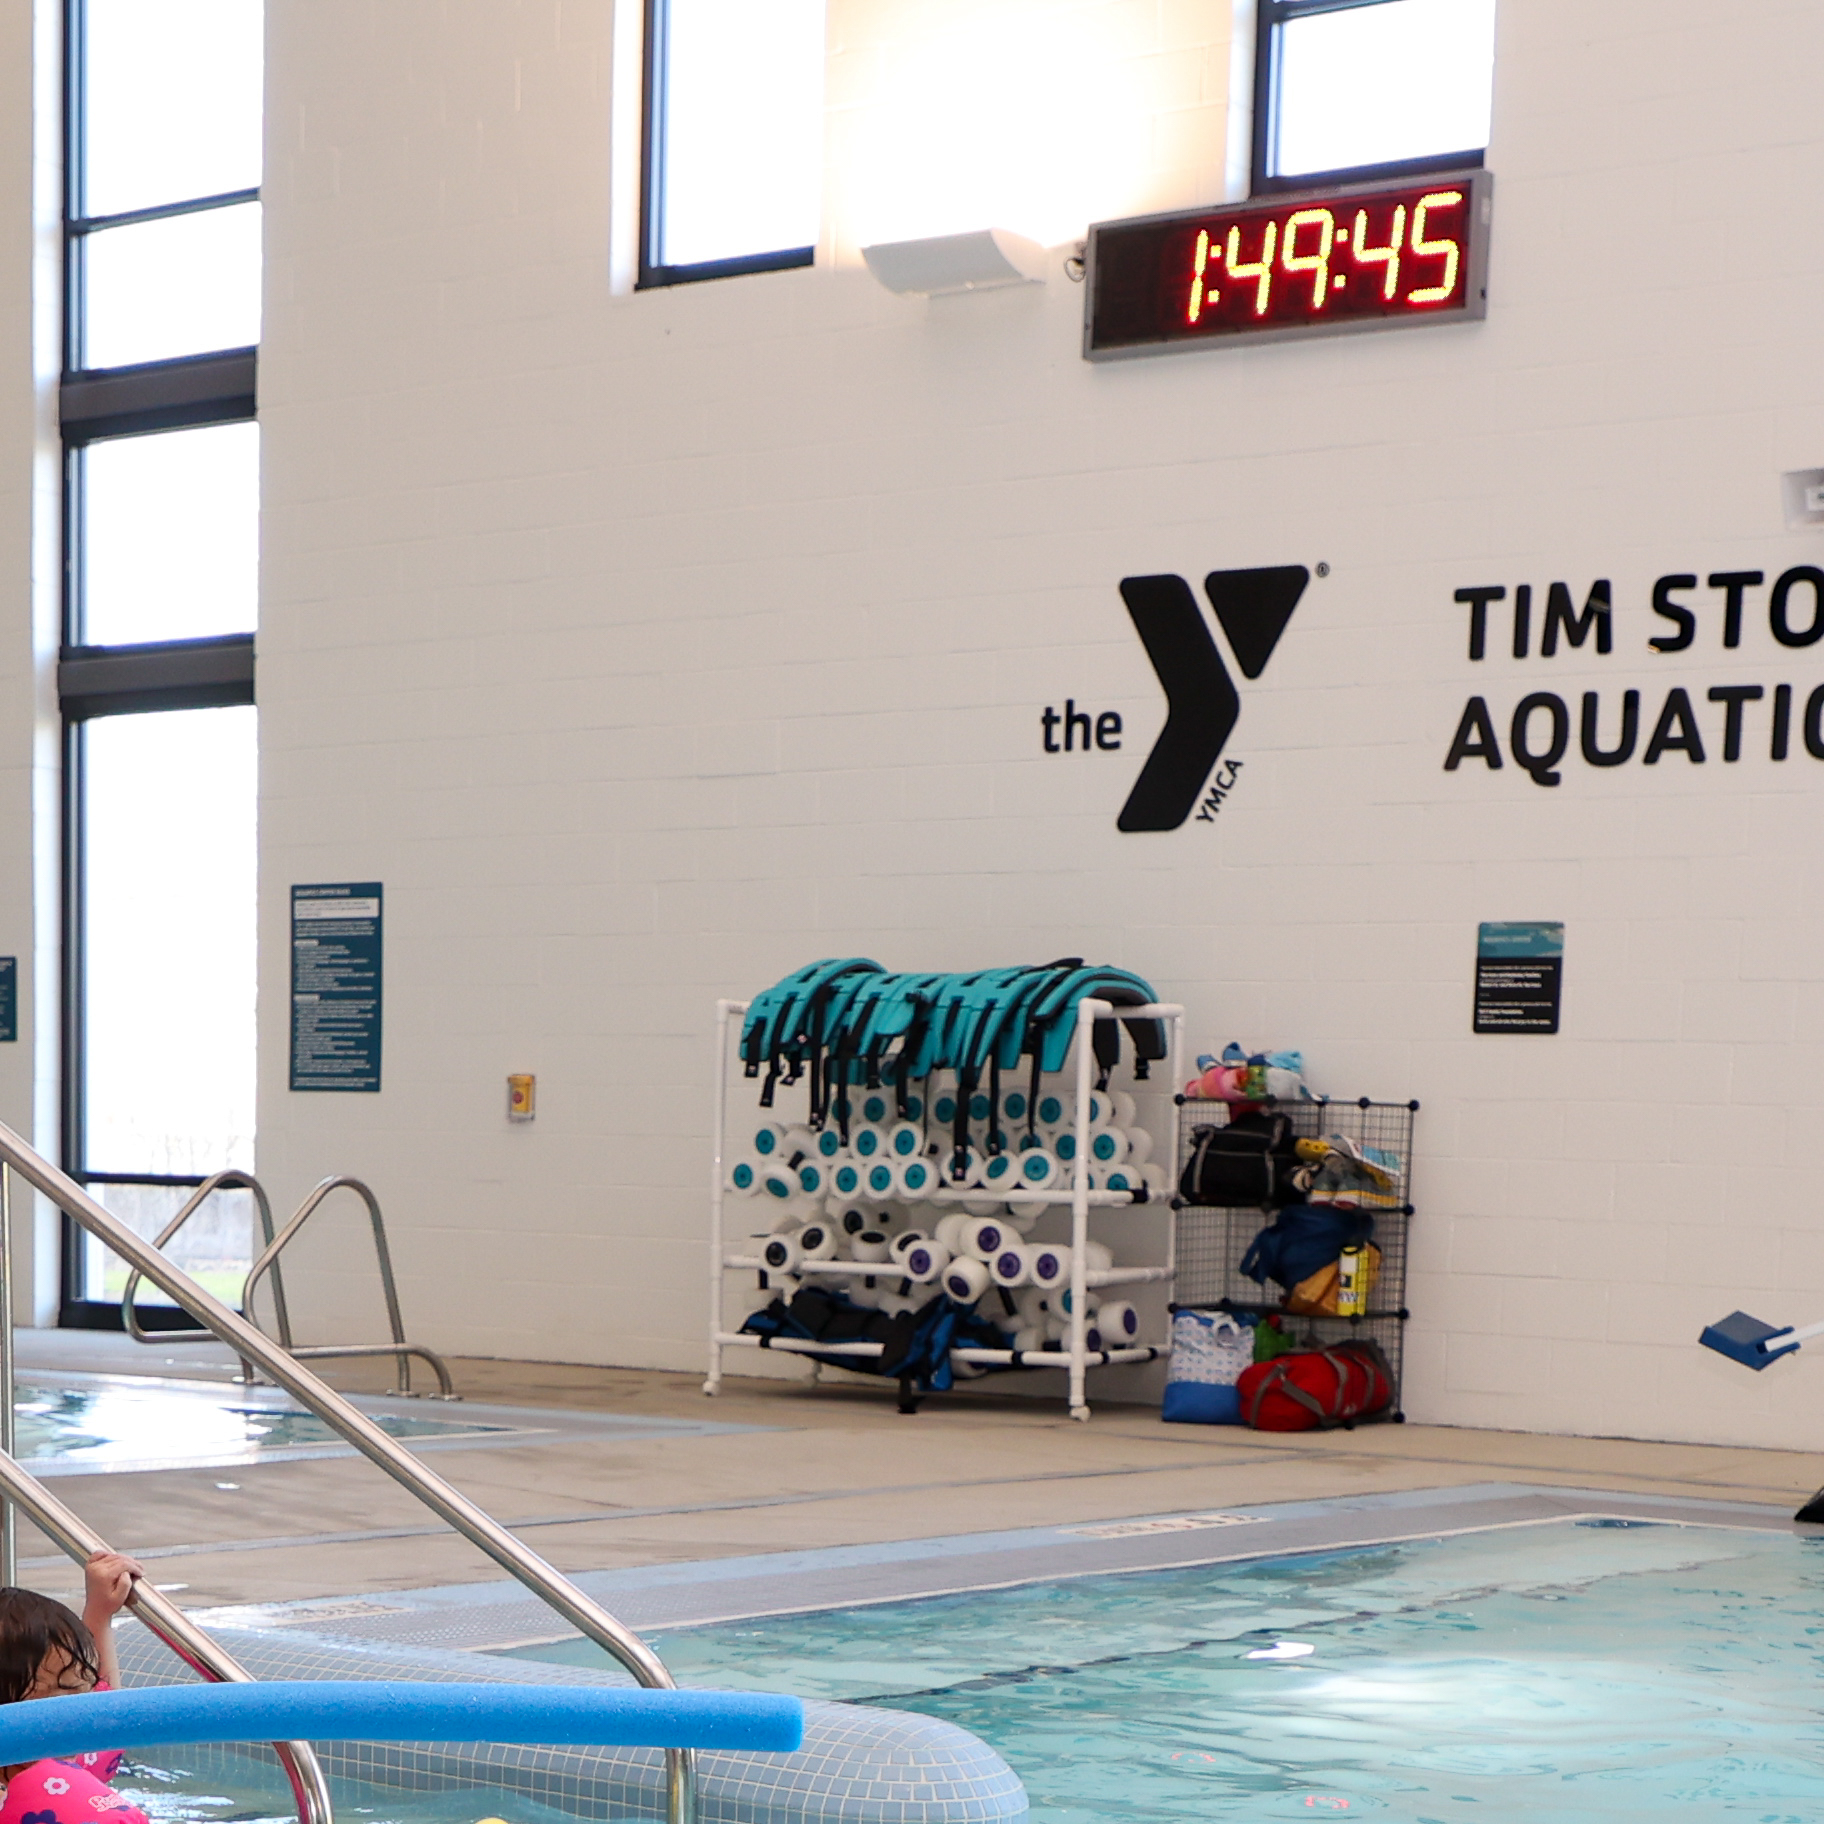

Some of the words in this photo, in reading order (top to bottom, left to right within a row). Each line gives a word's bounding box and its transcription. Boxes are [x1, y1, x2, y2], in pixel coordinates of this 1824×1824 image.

[1187, 189, 1465, 324] 1:49:45
[1453, 578, 1613, 661] TIM
[1041, 699, 1124, 753] the
[1117, 564, 1310, 832] Y
[1195, 758, 1245, 825] YMCA
